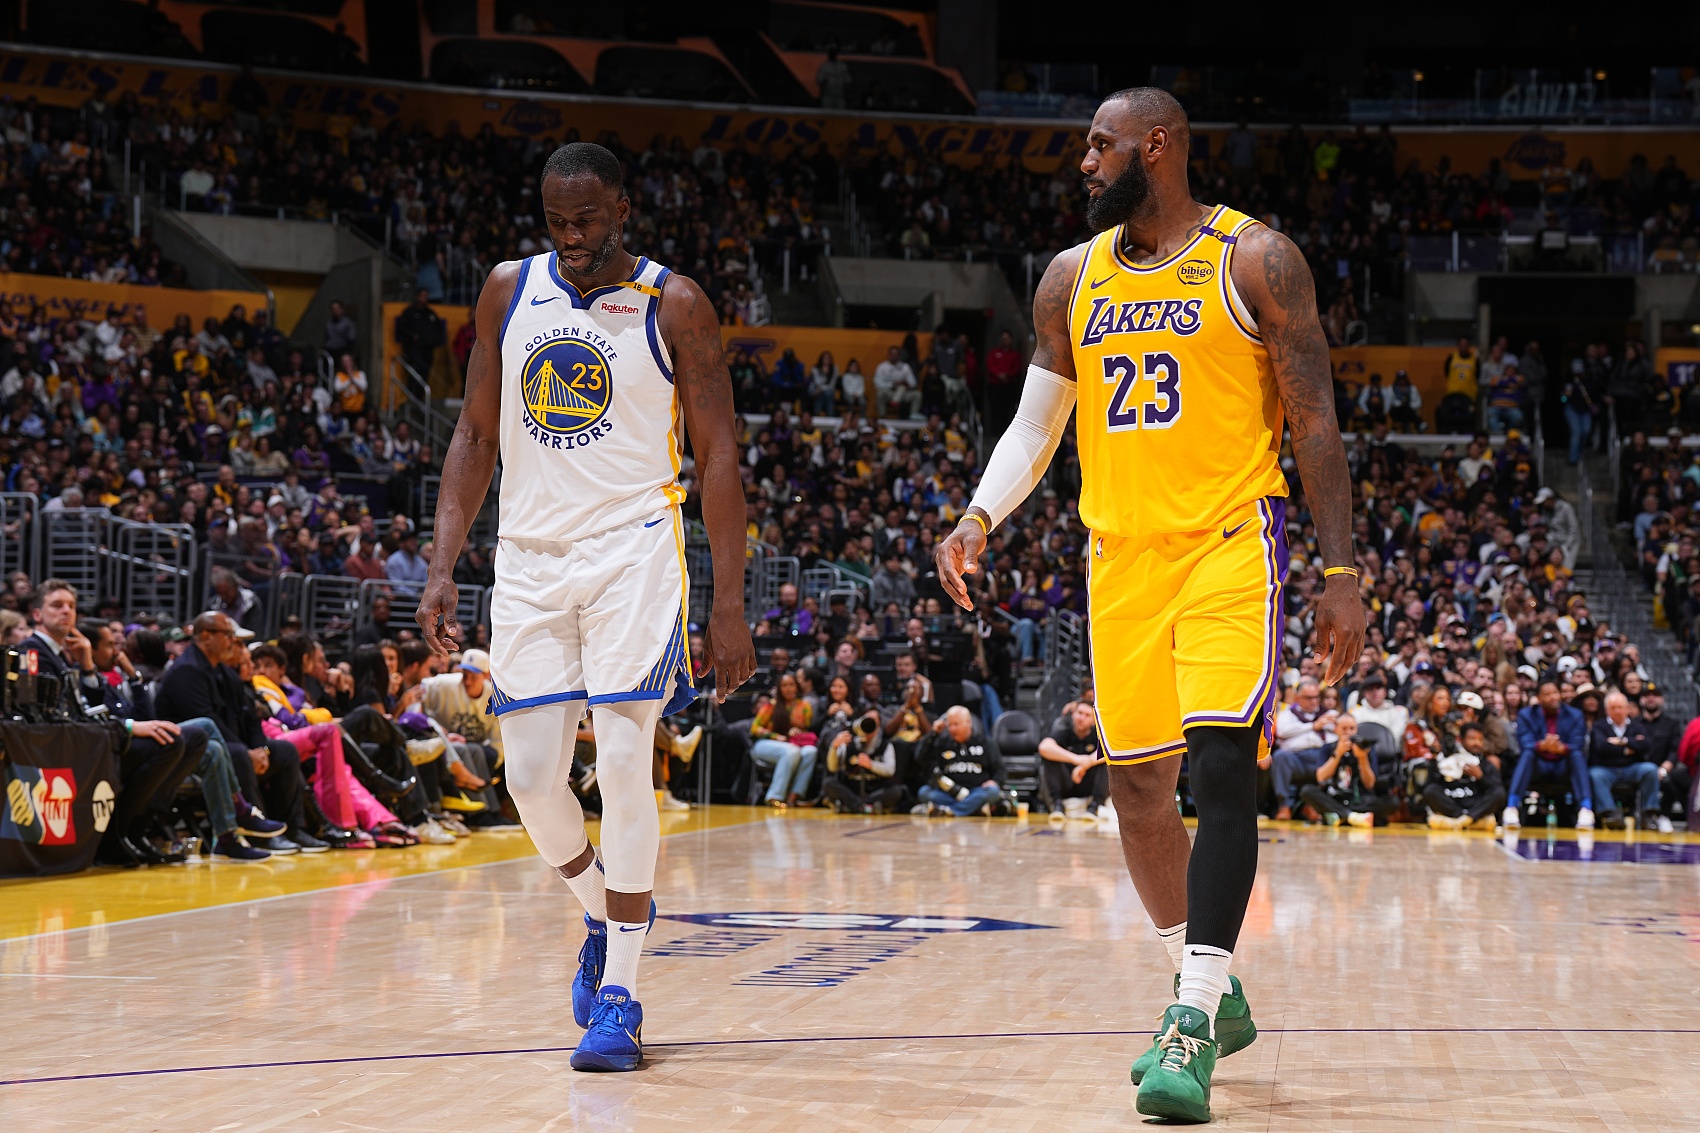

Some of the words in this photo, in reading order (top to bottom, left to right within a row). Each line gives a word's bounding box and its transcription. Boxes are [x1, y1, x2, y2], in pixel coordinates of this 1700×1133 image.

[702, 115, 826, 144] LOS
[1181, 266, 1212, 277] bibigo
[633, 283, 642, 291] 16
[601, 303, 639, 314] Rakuten
[1080, 296, 1204, 348] LAKERS
[525, 327, 580, 352] GOLDEN
[585, 331, 618, 361] STATE
[570, 363, 603, 390] 23
[1101, 351, 1182, 433] 23
[522, 410, 613, 450] WARRIORS
